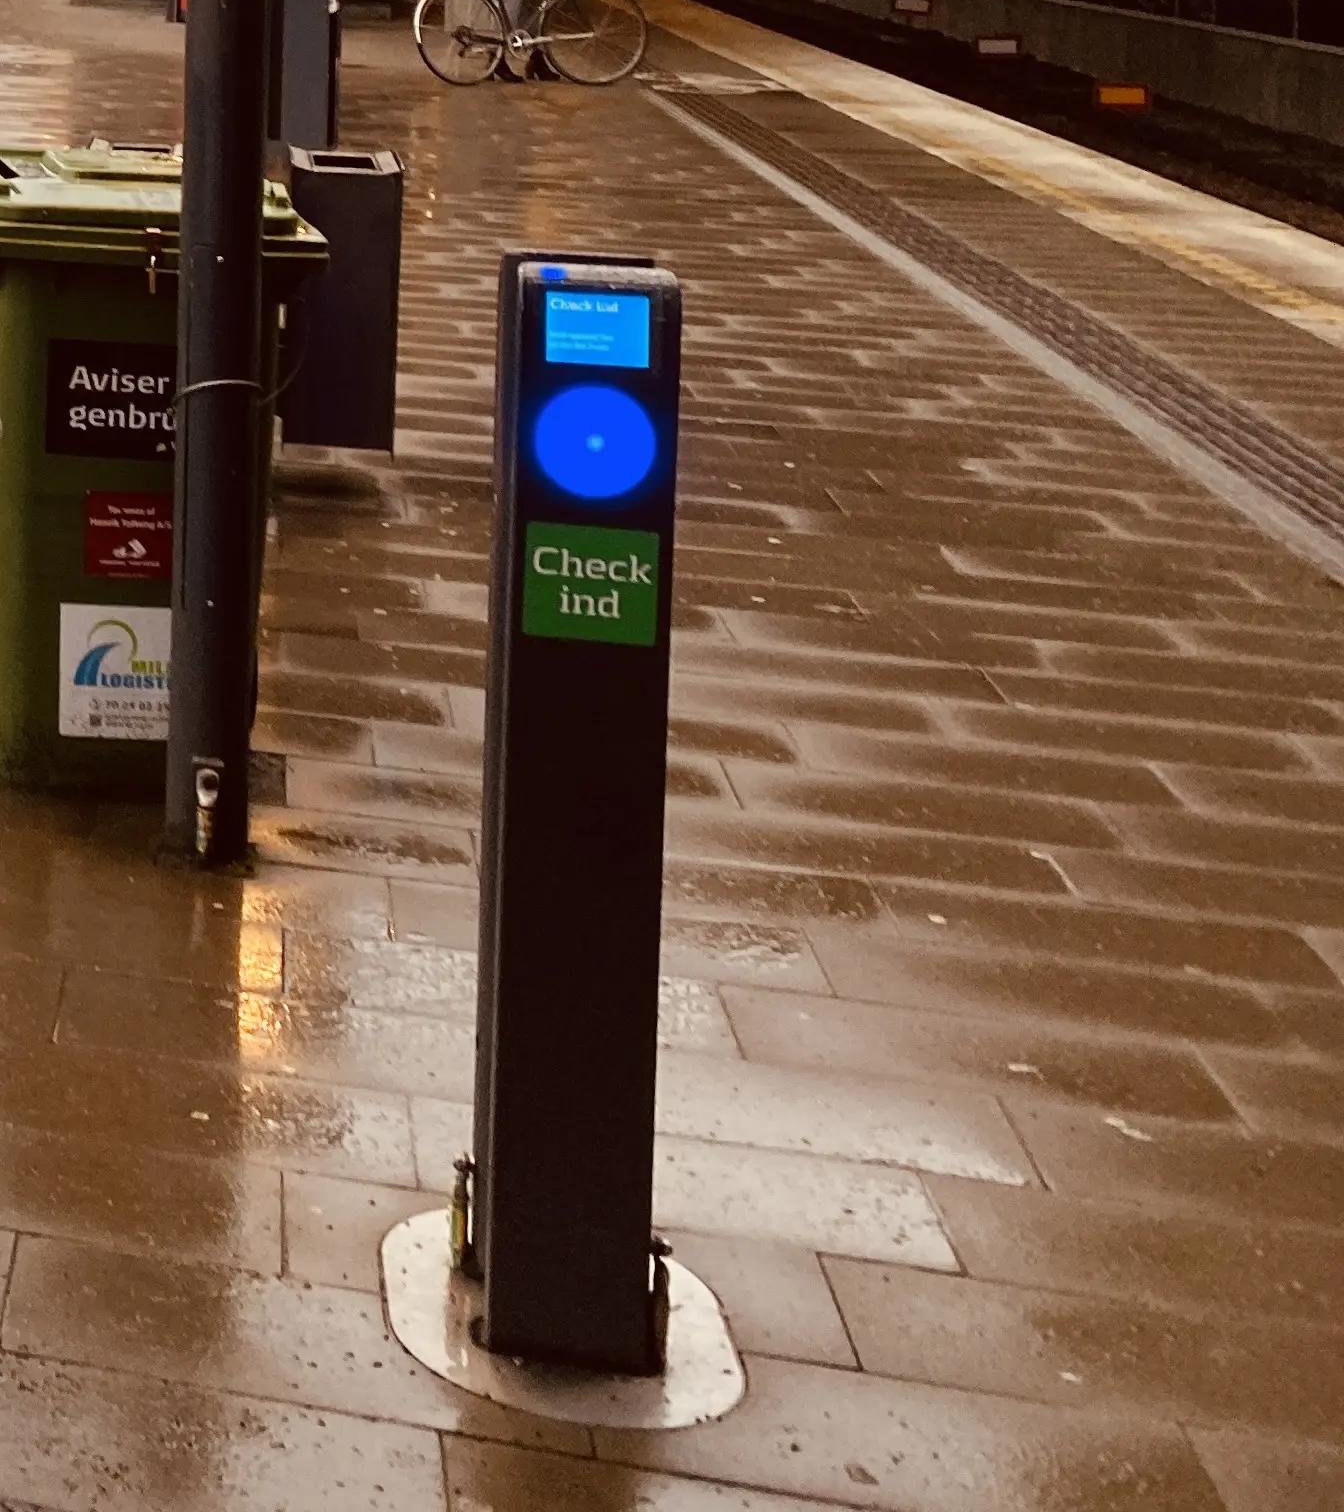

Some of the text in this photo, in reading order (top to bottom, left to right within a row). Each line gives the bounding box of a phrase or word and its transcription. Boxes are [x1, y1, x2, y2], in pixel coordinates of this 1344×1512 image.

[69, 365, 170, 394] Aviser
[533, 546, 653, 585] Check
[559, 584, 621, 619] ind
